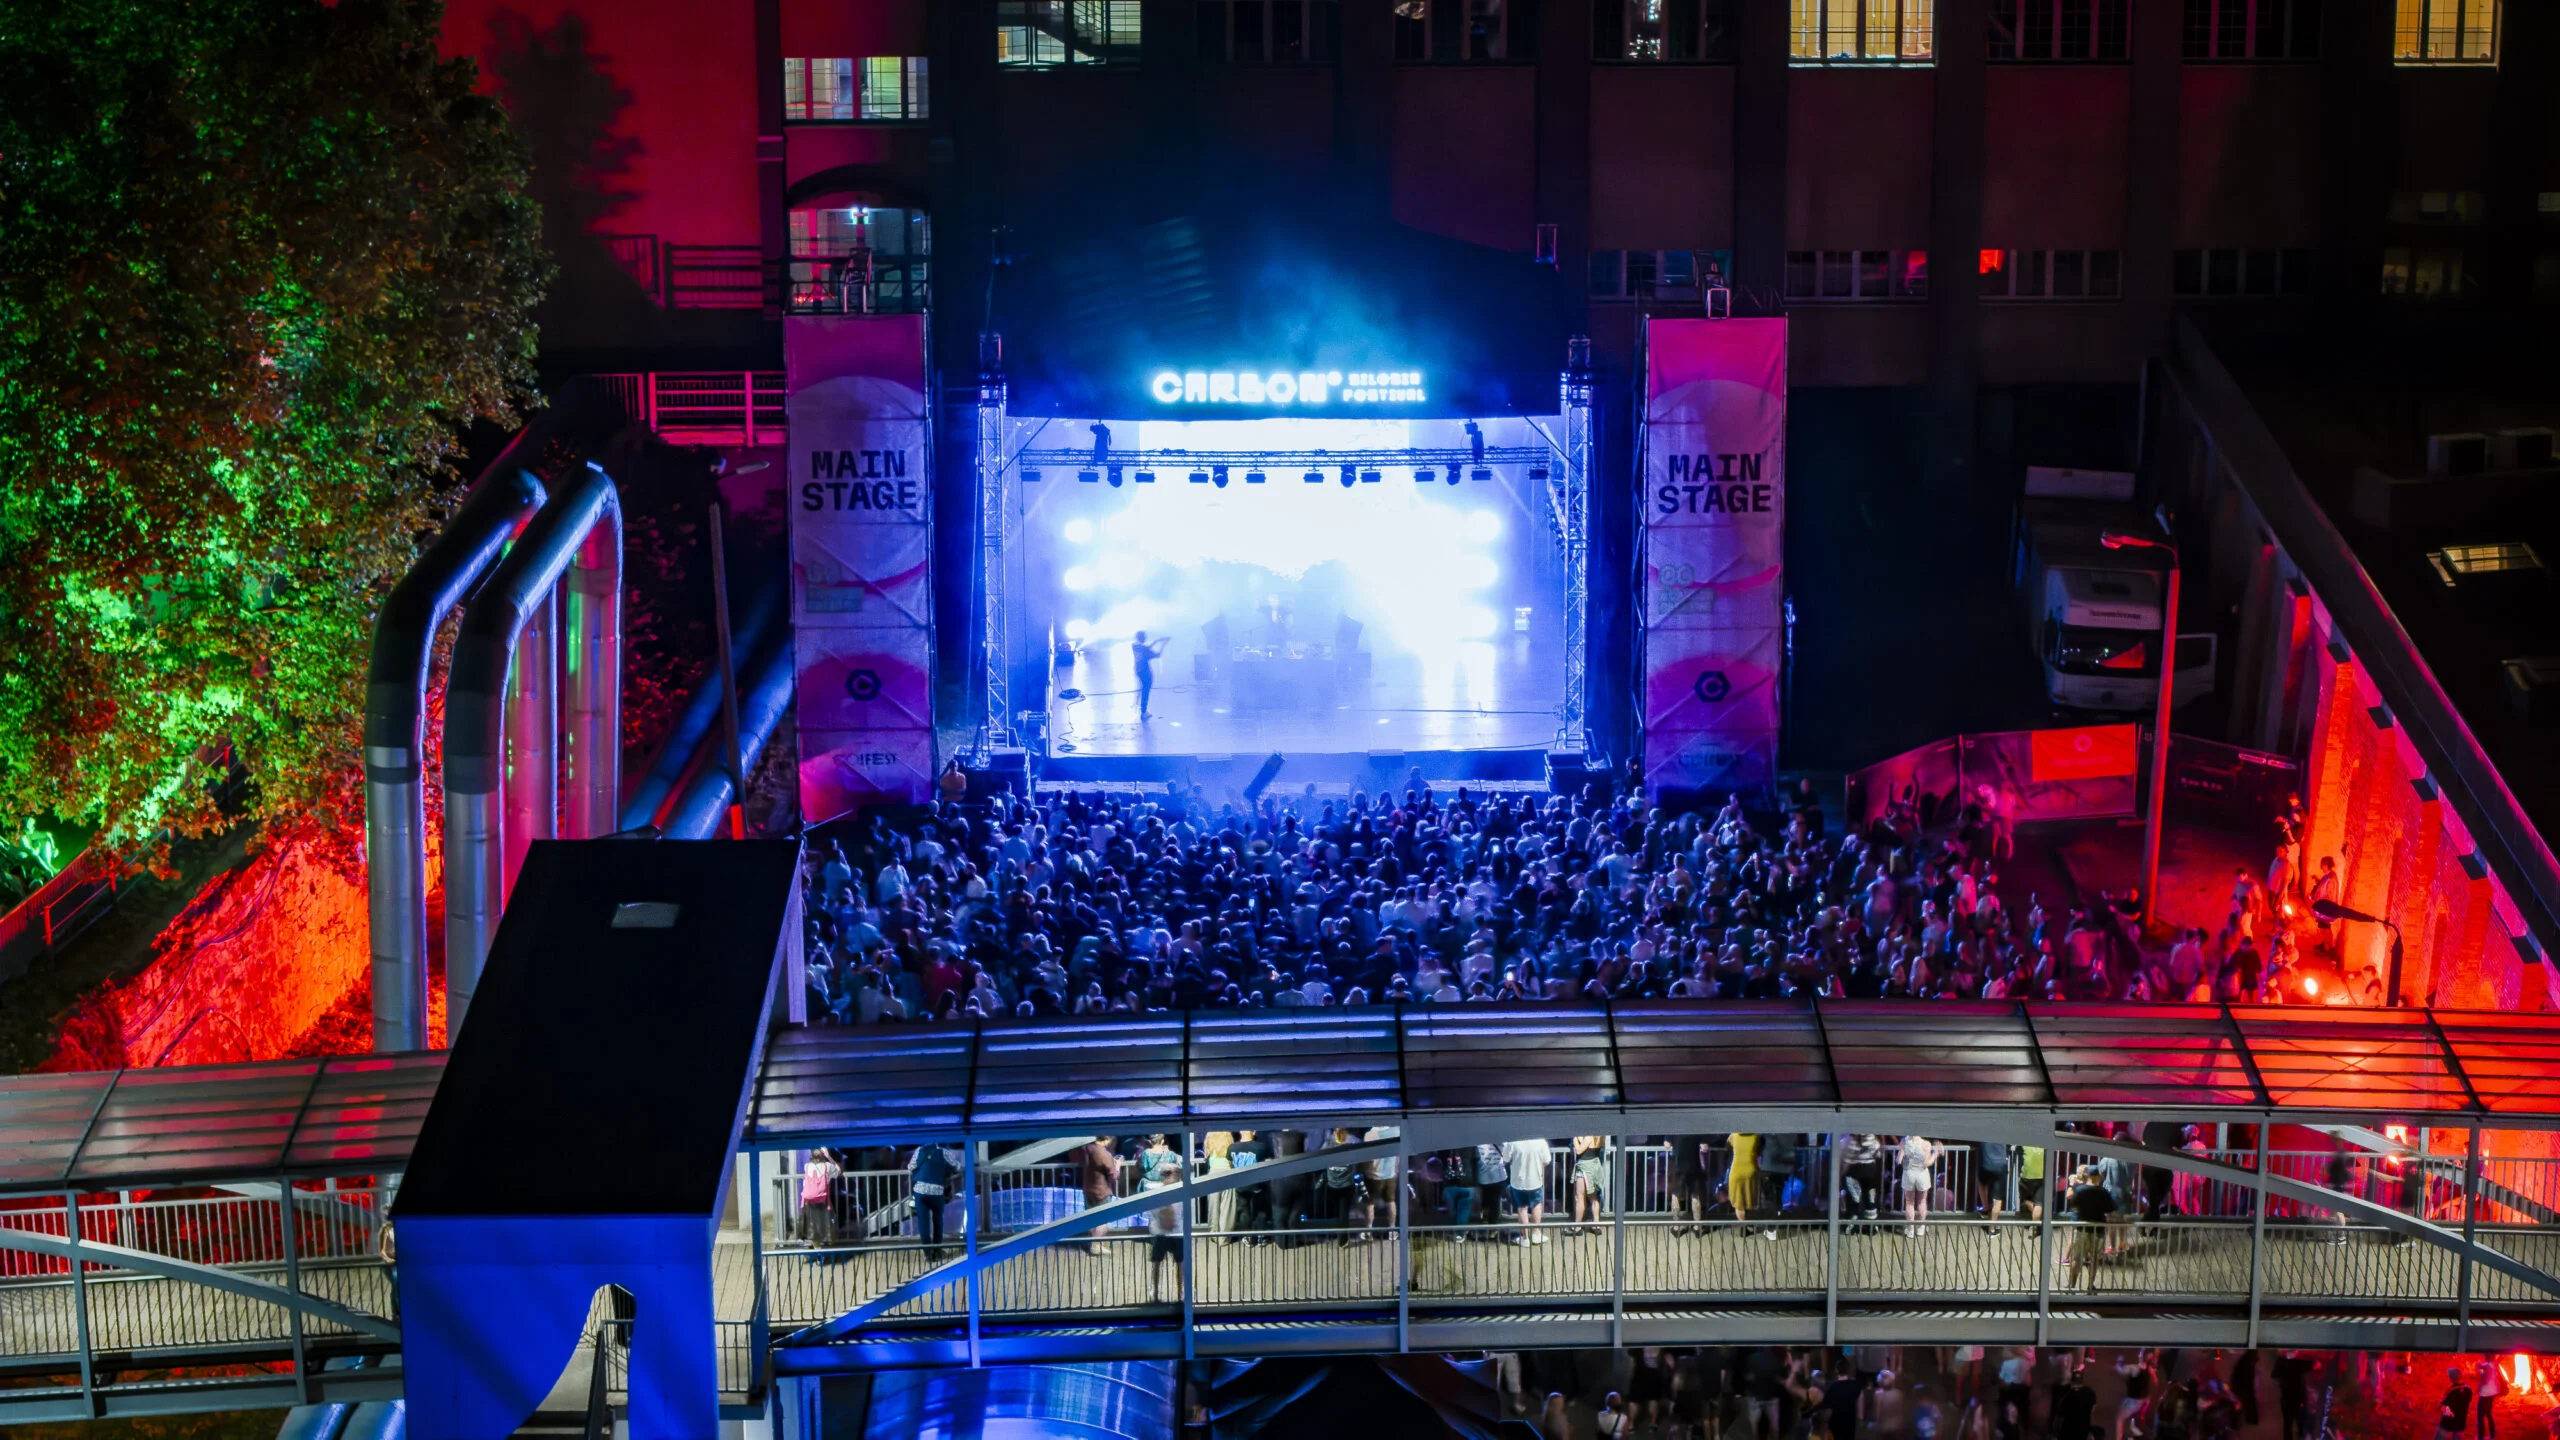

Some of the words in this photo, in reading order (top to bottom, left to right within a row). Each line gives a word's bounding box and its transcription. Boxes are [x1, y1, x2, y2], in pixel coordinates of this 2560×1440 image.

[812, 450, 904, 478] MAIN
[1669, 454, 1761, 482] MAIN
[803, 482, 917, 511] STAGE
[1658, 485, 1771, 514] STAGE
